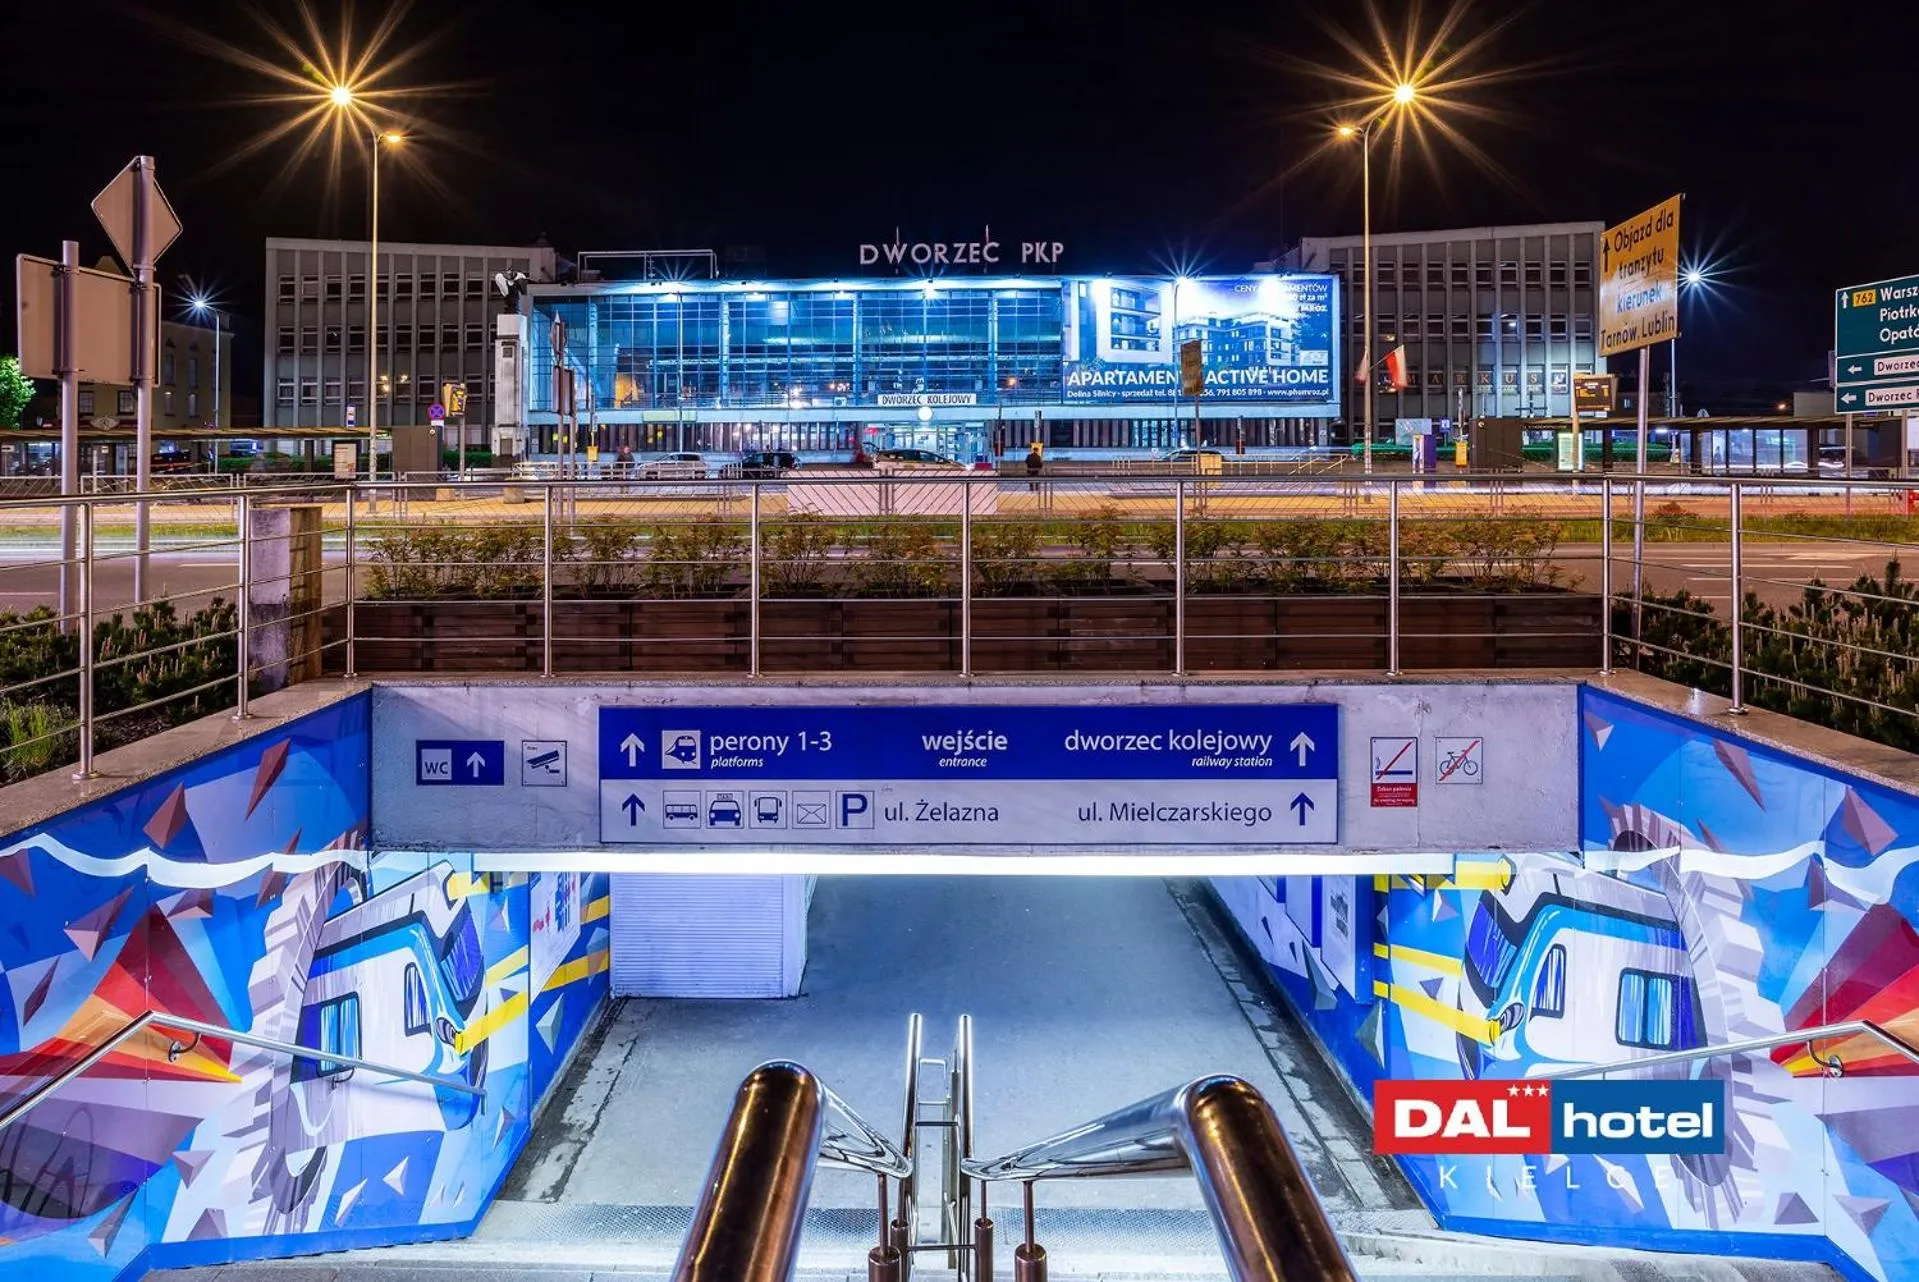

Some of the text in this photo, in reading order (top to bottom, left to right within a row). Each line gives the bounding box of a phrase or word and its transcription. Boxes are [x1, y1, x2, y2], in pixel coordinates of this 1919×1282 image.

[1613, 208, 1674, 253] Objazd dla
[860, 241, 1065, 264] DWORZEC PKP
[1618, 247, 1665, 280] tranzytu
[1234, 285, 1257, 293] CENY
[1616, 282, 1663, 313] kierunek
[1880, 286, 1919, 301] Warsz
[1855, 292, 1874, 304] 762
[1642, 310, 1675, 338] Lublin
[1067, 369, 1329, 386] APARTAMEN ACTIVE HOME
[881, 394, 972, 405] DWORZEC KOLEJOWY
[1067, 390, 1092, 398] Dolina
[1216, 388, 1231, 396] 791
[1868, 390, 1912, 403] Dworzec
[709, 731, 833, 757] perony 1-3
[921, 730, 1008, 756] wejście
[1064, 729, 1273, 755] dworzec kolejowy
[424, 761, 449, 775] WC
[710, 755, 764, 769] platforms
[938, 757, 988, 768] entrance
[1191, 755, 1273, 769] railway station
[884, 798, 1001, 823] ul. Żelazna
[1077, 801, 1272, 826] ul. Mielczarskiego
